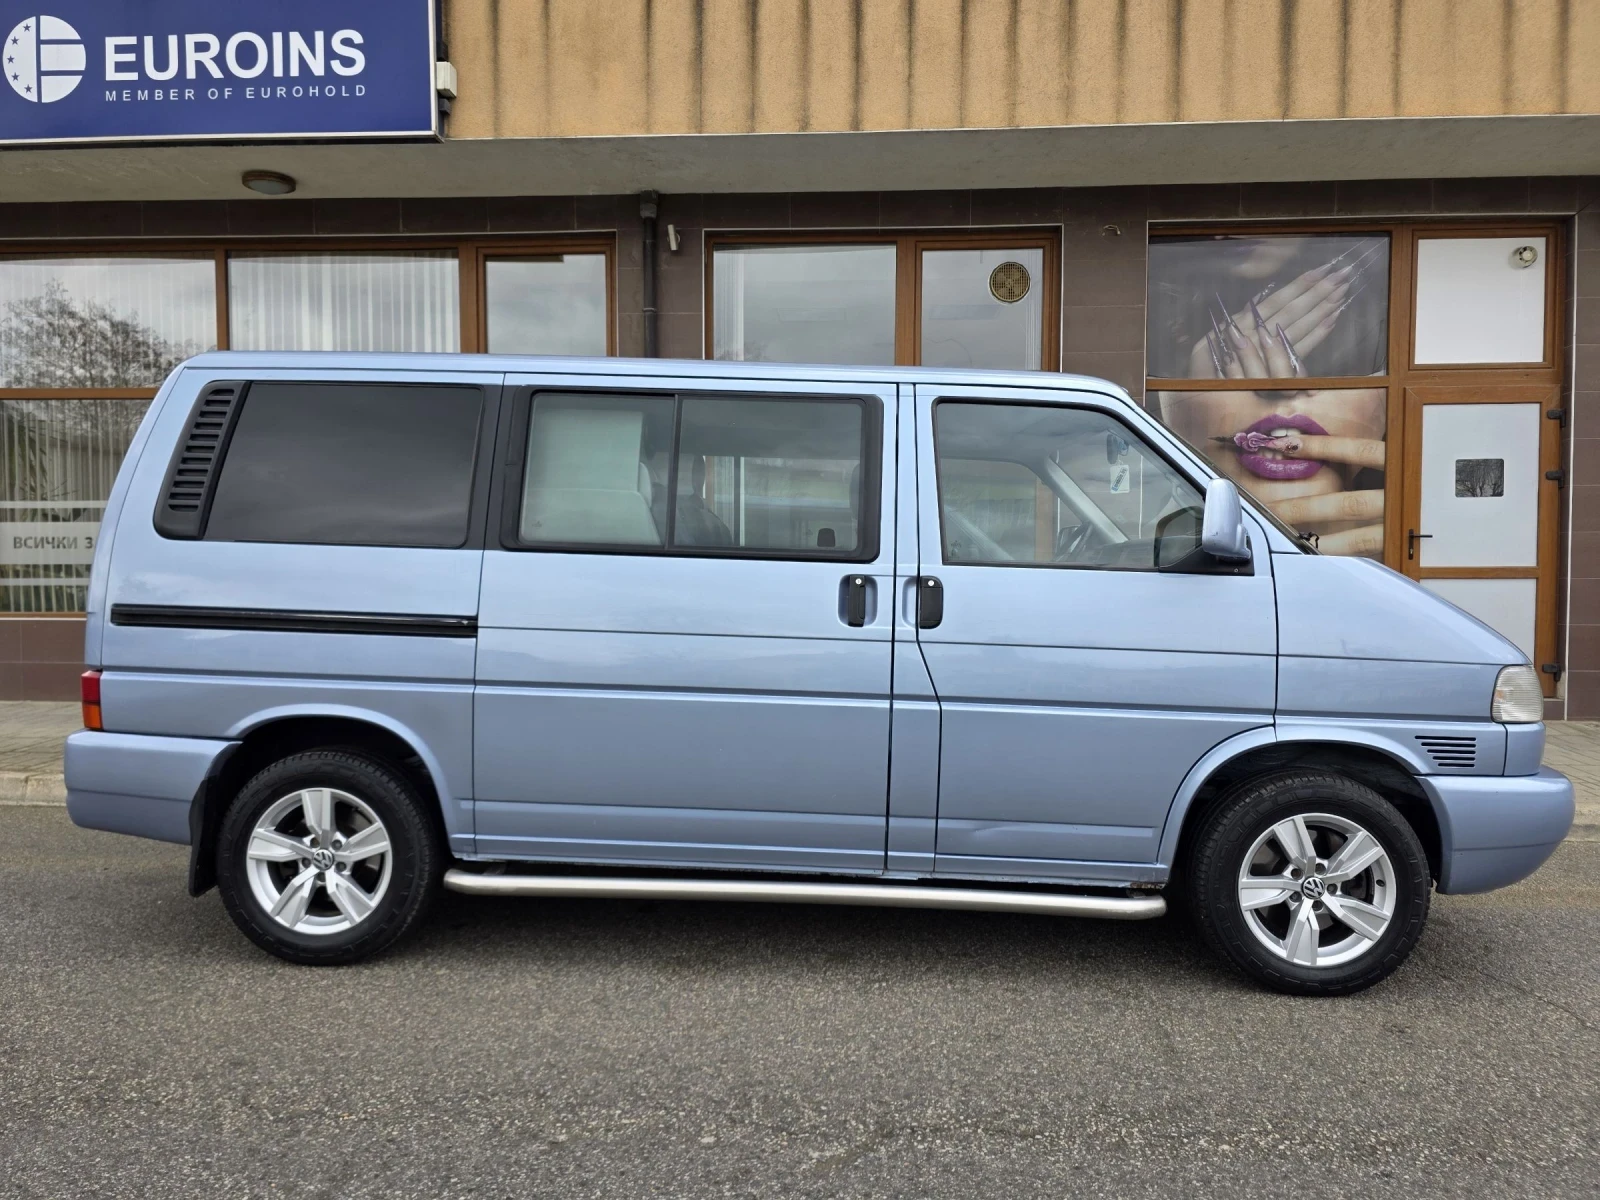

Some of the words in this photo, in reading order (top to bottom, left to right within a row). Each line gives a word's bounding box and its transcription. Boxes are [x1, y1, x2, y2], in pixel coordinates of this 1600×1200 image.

[105, 29, 366, 81] EUROINS
[106, 88, 195, 102] MEMBER
[207, 87, 233, 100] OF
[245, 84, 366, 99] EUROHOLD
[13, 536, 77, 549] ВСИЧКИ
[1303, 877, 1324, 898] VW
